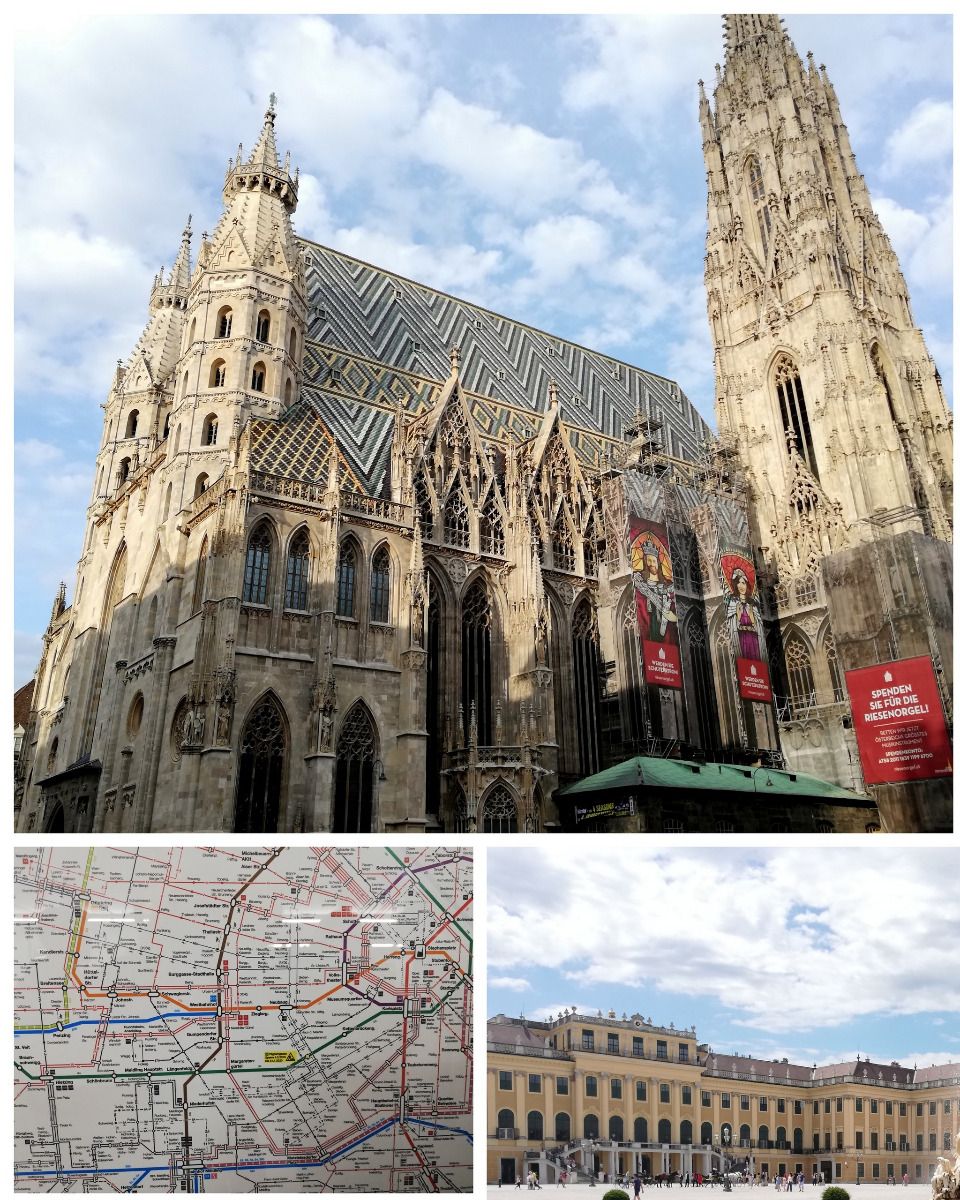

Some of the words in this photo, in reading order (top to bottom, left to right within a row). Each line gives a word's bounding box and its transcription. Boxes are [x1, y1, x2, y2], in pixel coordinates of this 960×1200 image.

[871, 684, 912, 699] SPENDEN
[869, 701, 883, 711] SIE
[884, 697, 902, 708] FÜR
[903, 694, 919, 705] DIE
[864, 704, 930, 722] RIESENORGEL!
